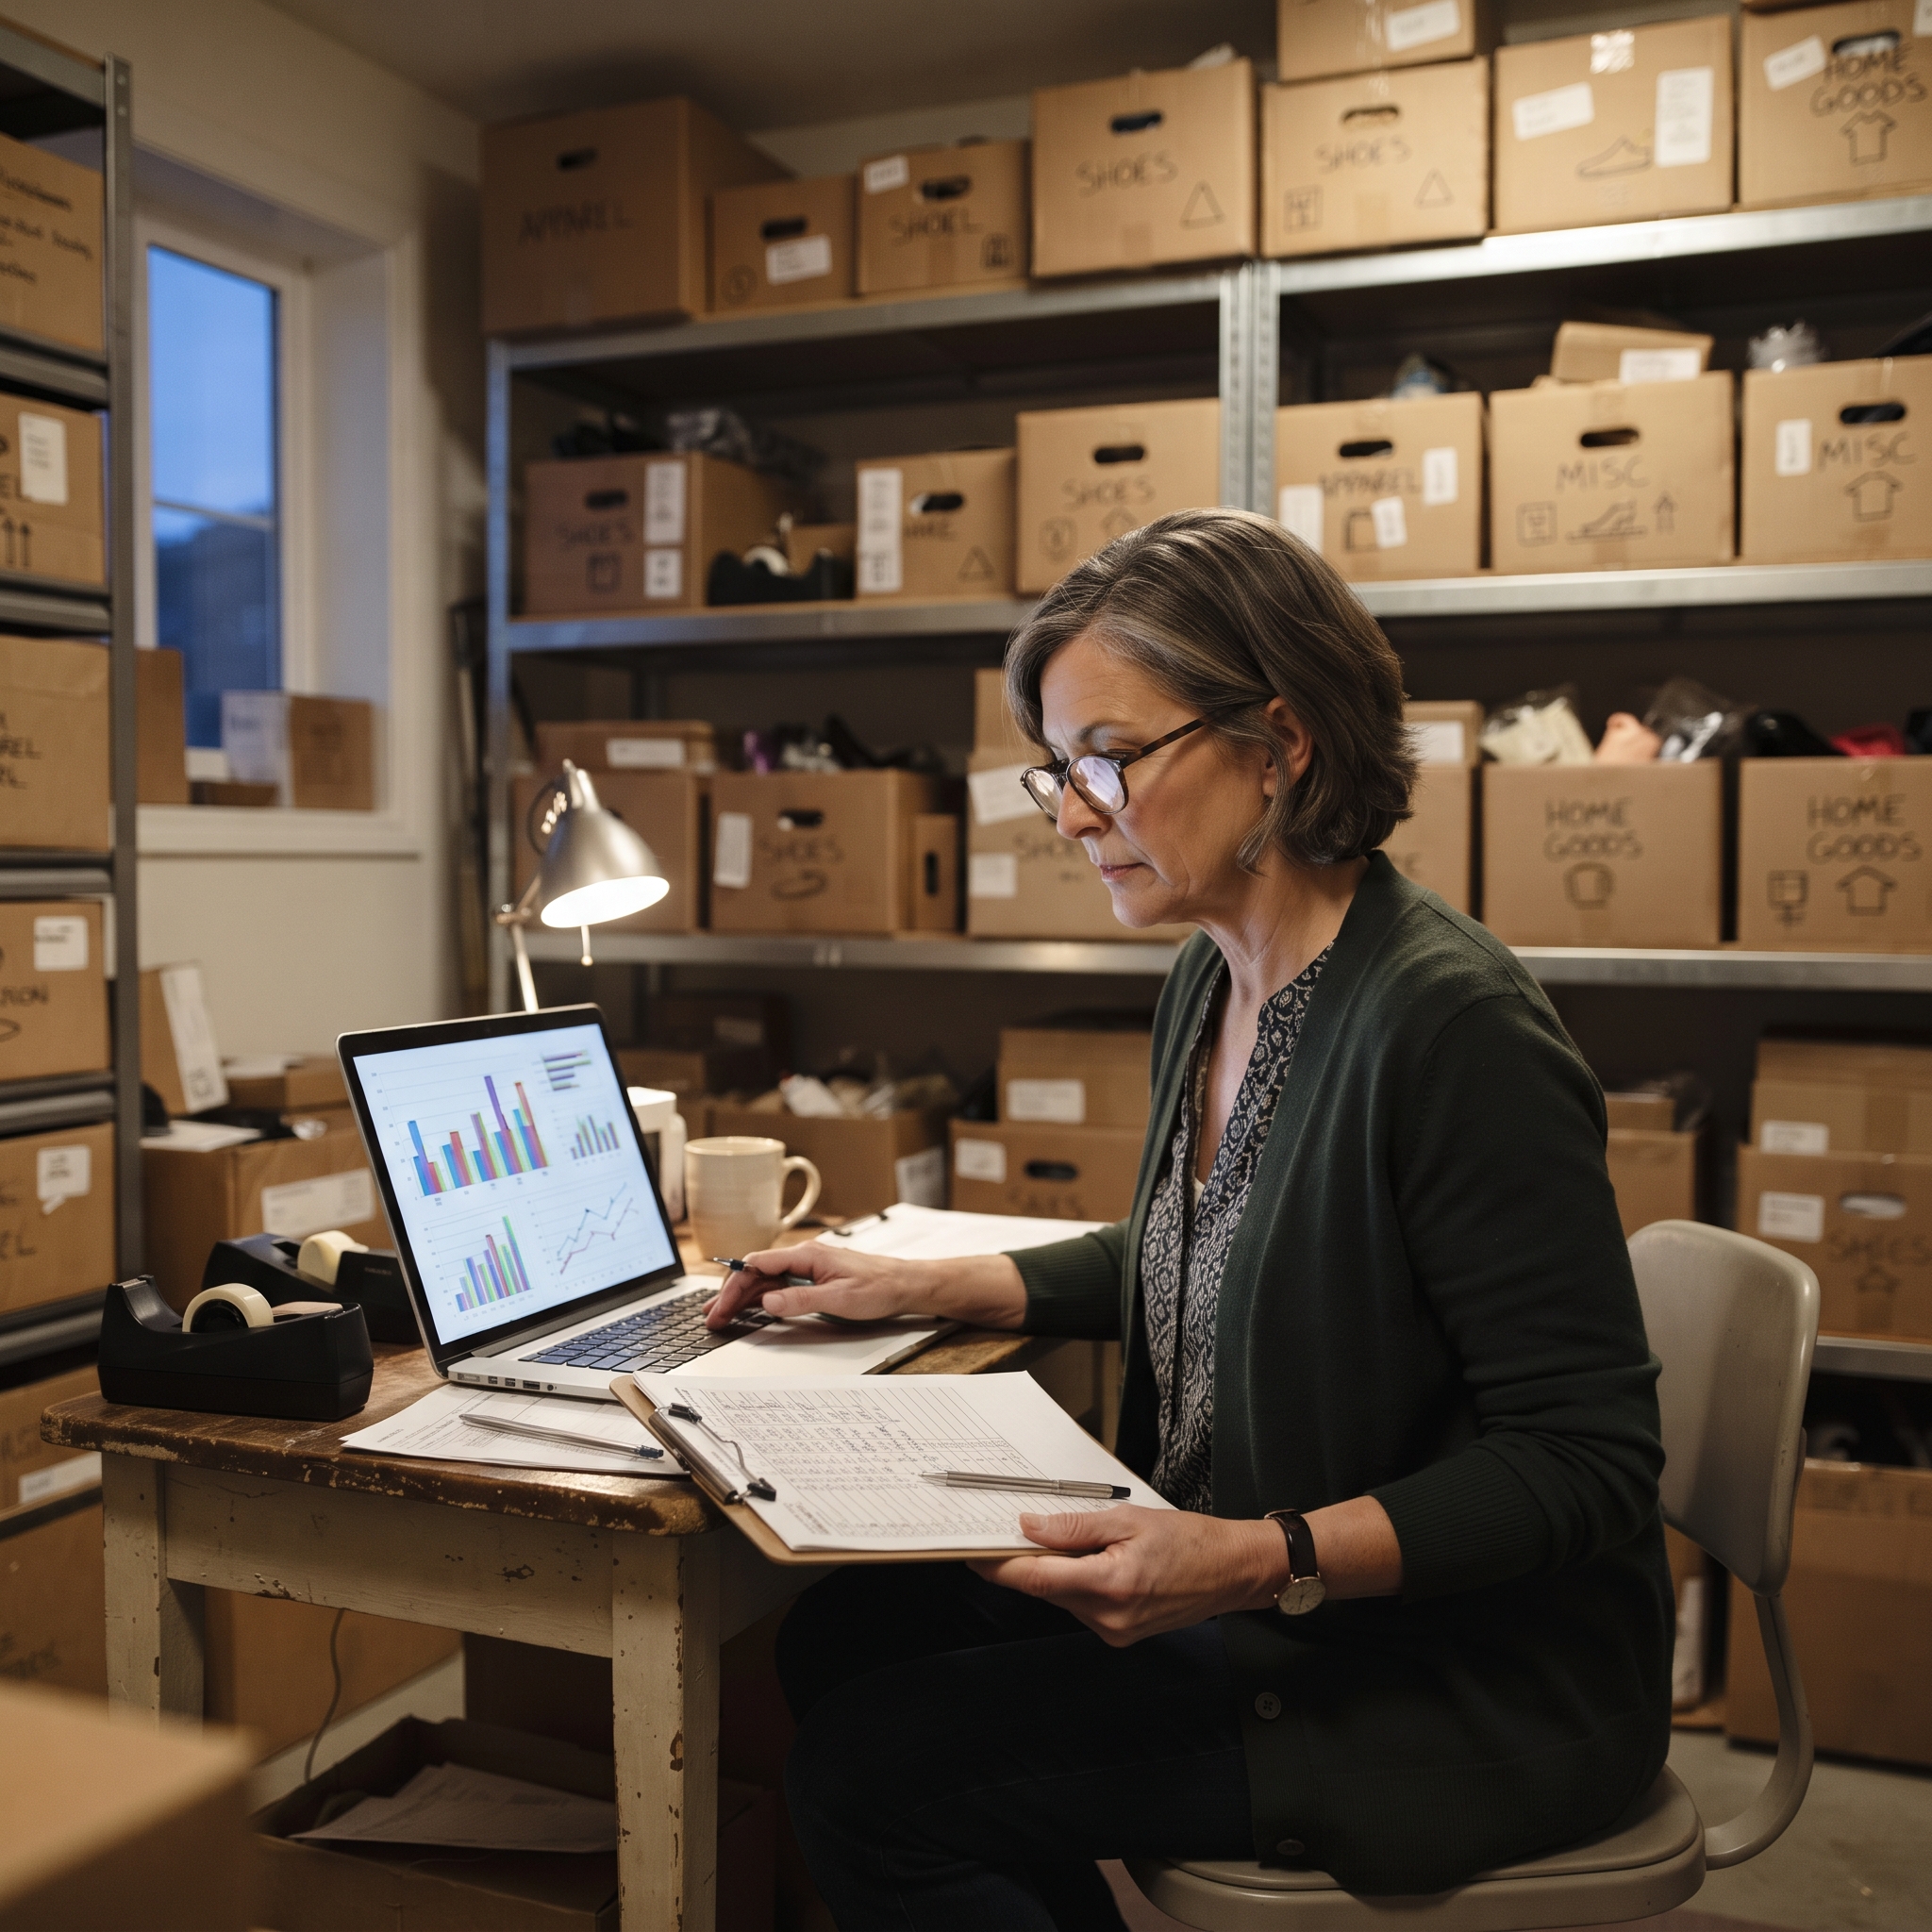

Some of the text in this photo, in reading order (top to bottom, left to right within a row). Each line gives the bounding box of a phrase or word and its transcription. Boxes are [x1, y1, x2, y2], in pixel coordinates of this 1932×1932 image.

[1824, 42, 1913, 82] HOME
[1809, 73, 1927, 117] GOODS
[1075, 150, 1178, 198] SHOES
[1314, 134, 1412, 175] SHOES
[1818, 430, 1919, 473] MISC
[1061, 475, 1156, 510] SHOES
[1555, 455, 1651, 494] MISC
[1544, 795, 1632, 828] HOME
[1806, 792, 1907, 828] HOME
[1543, 830, 1643, 862] GOODS
[1806, 831, 1924, 865] GOODS
